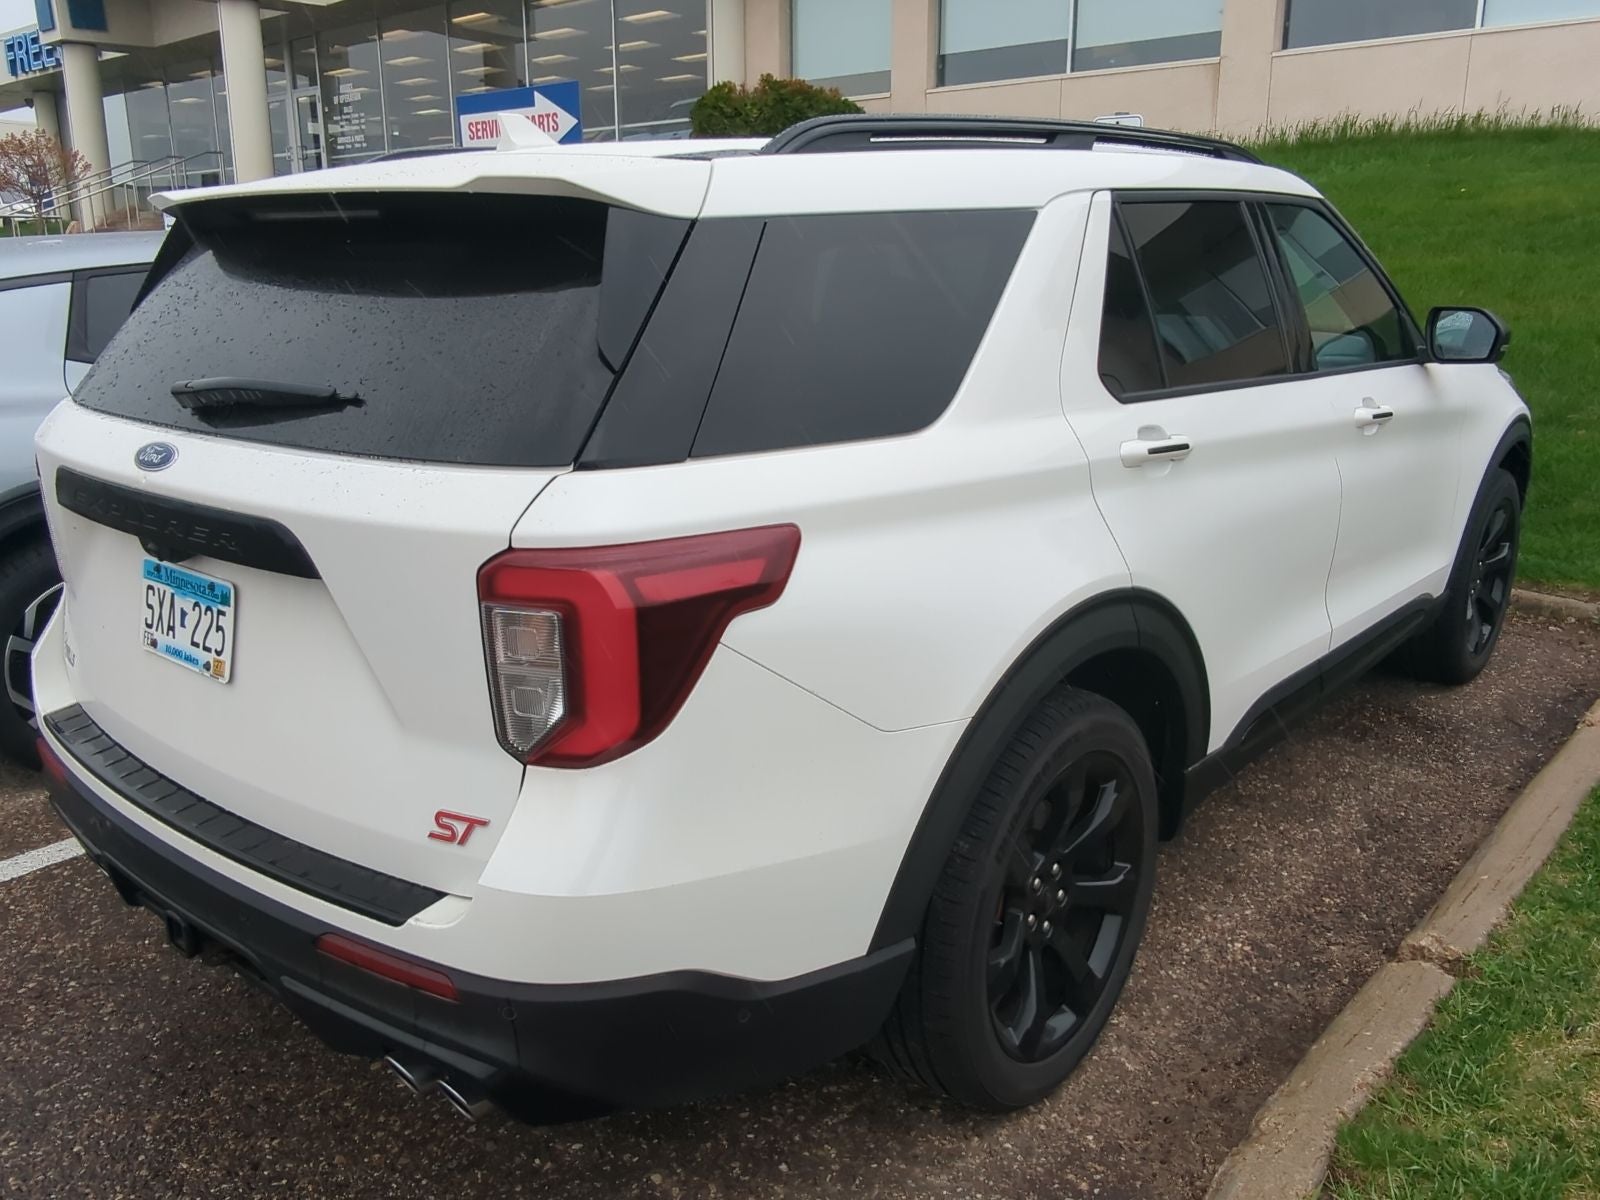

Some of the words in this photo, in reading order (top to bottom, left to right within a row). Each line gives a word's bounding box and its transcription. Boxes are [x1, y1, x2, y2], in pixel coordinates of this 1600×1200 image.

[467, 119, 502, 141] SERVI
[139, 445, 167, 463] Ford
[145, 584, 176, 640] SXA
[190, 601, 226, 657] 225
[427, 809, 491, 846] ST
